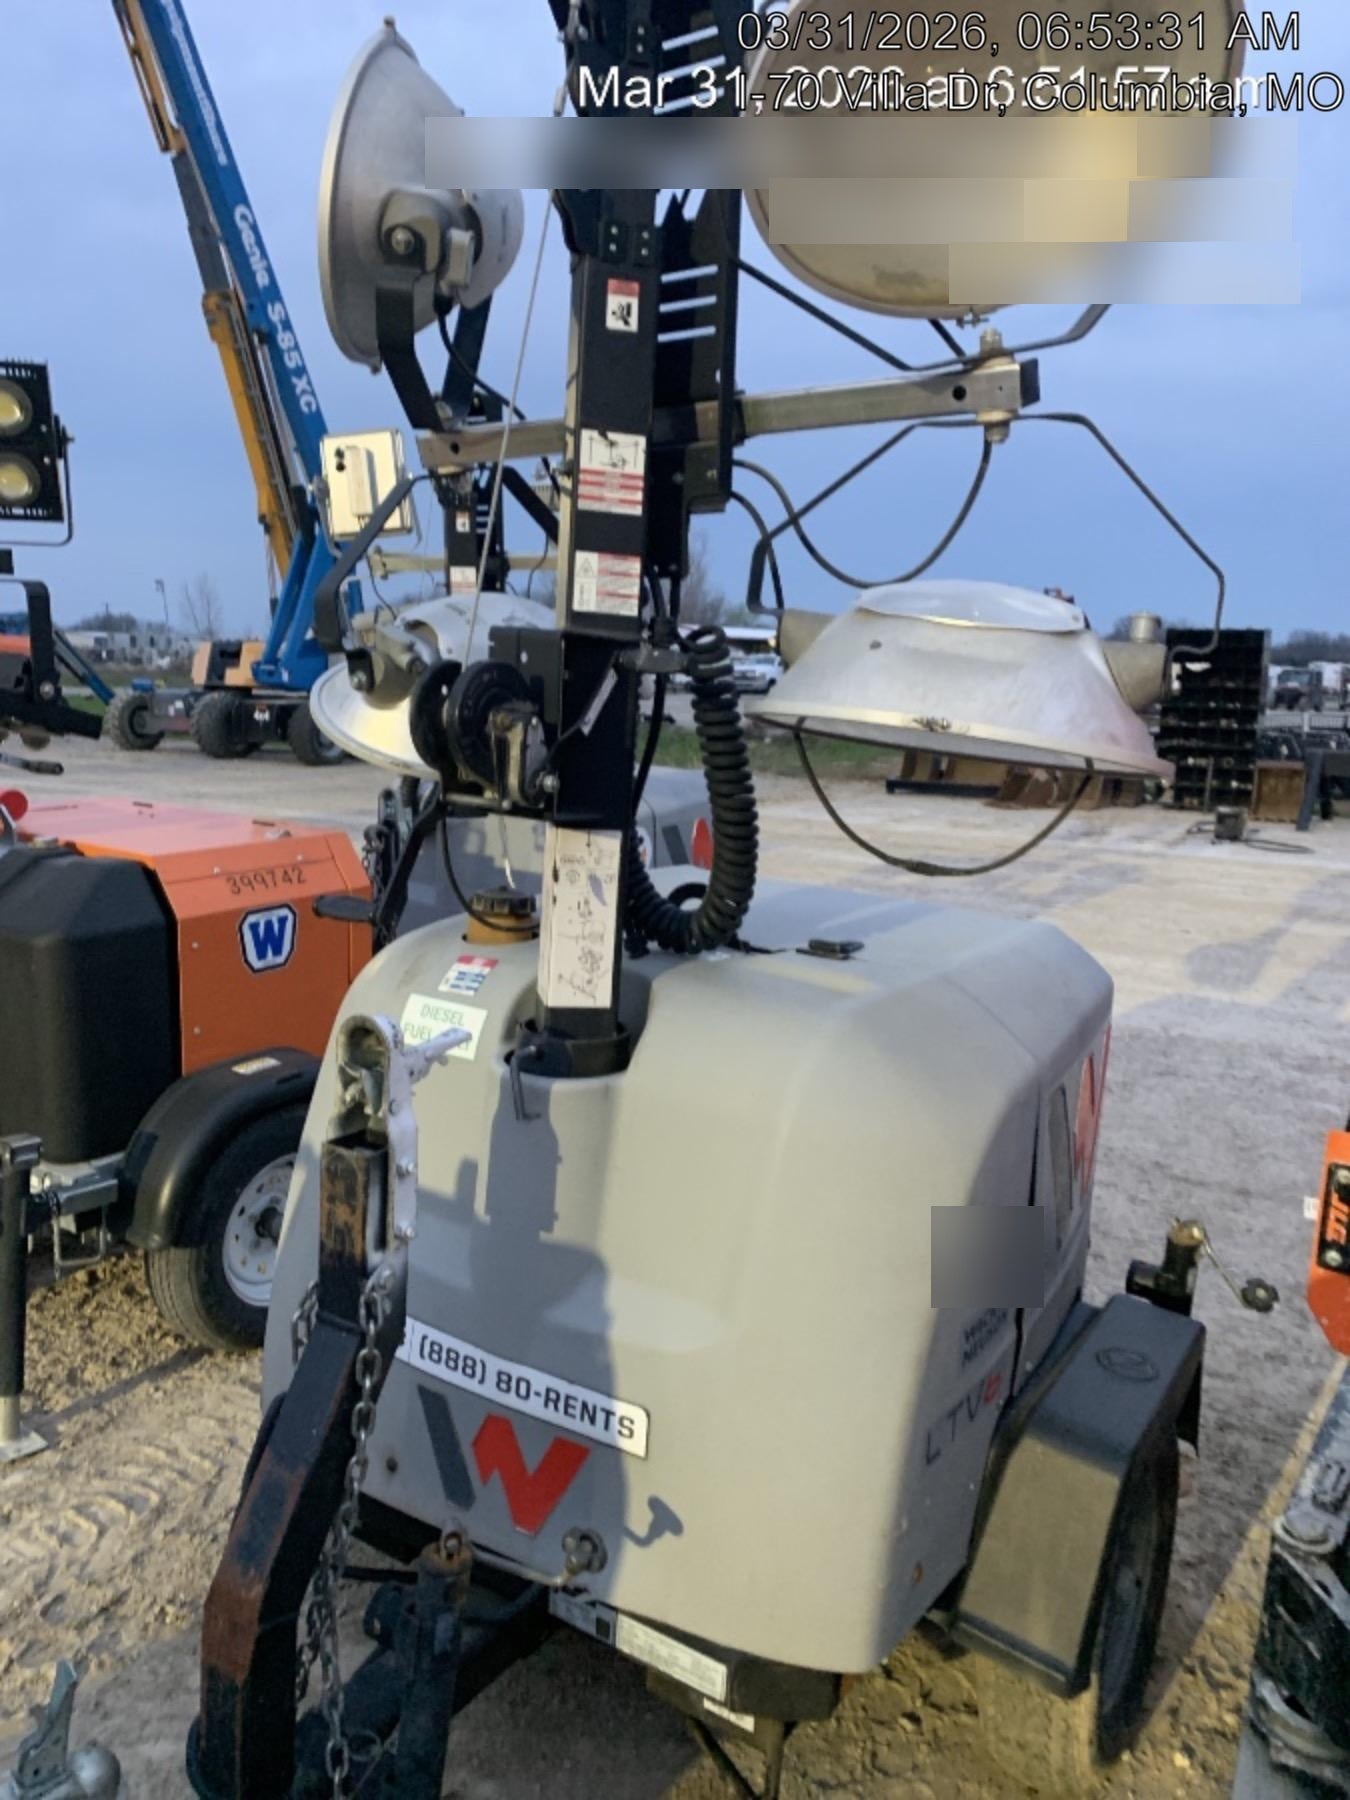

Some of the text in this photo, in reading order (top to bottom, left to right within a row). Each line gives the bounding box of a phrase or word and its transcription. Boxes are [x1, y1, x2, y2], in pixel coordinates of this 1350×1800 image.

[234, 204, 317, 414] Genie S-85 XC
[226, 866, 306, 895] 399742
[421, 1003, 465, 1027] DIESEL
[419, 1335, 635, 1440] (888) 80-RENTS
